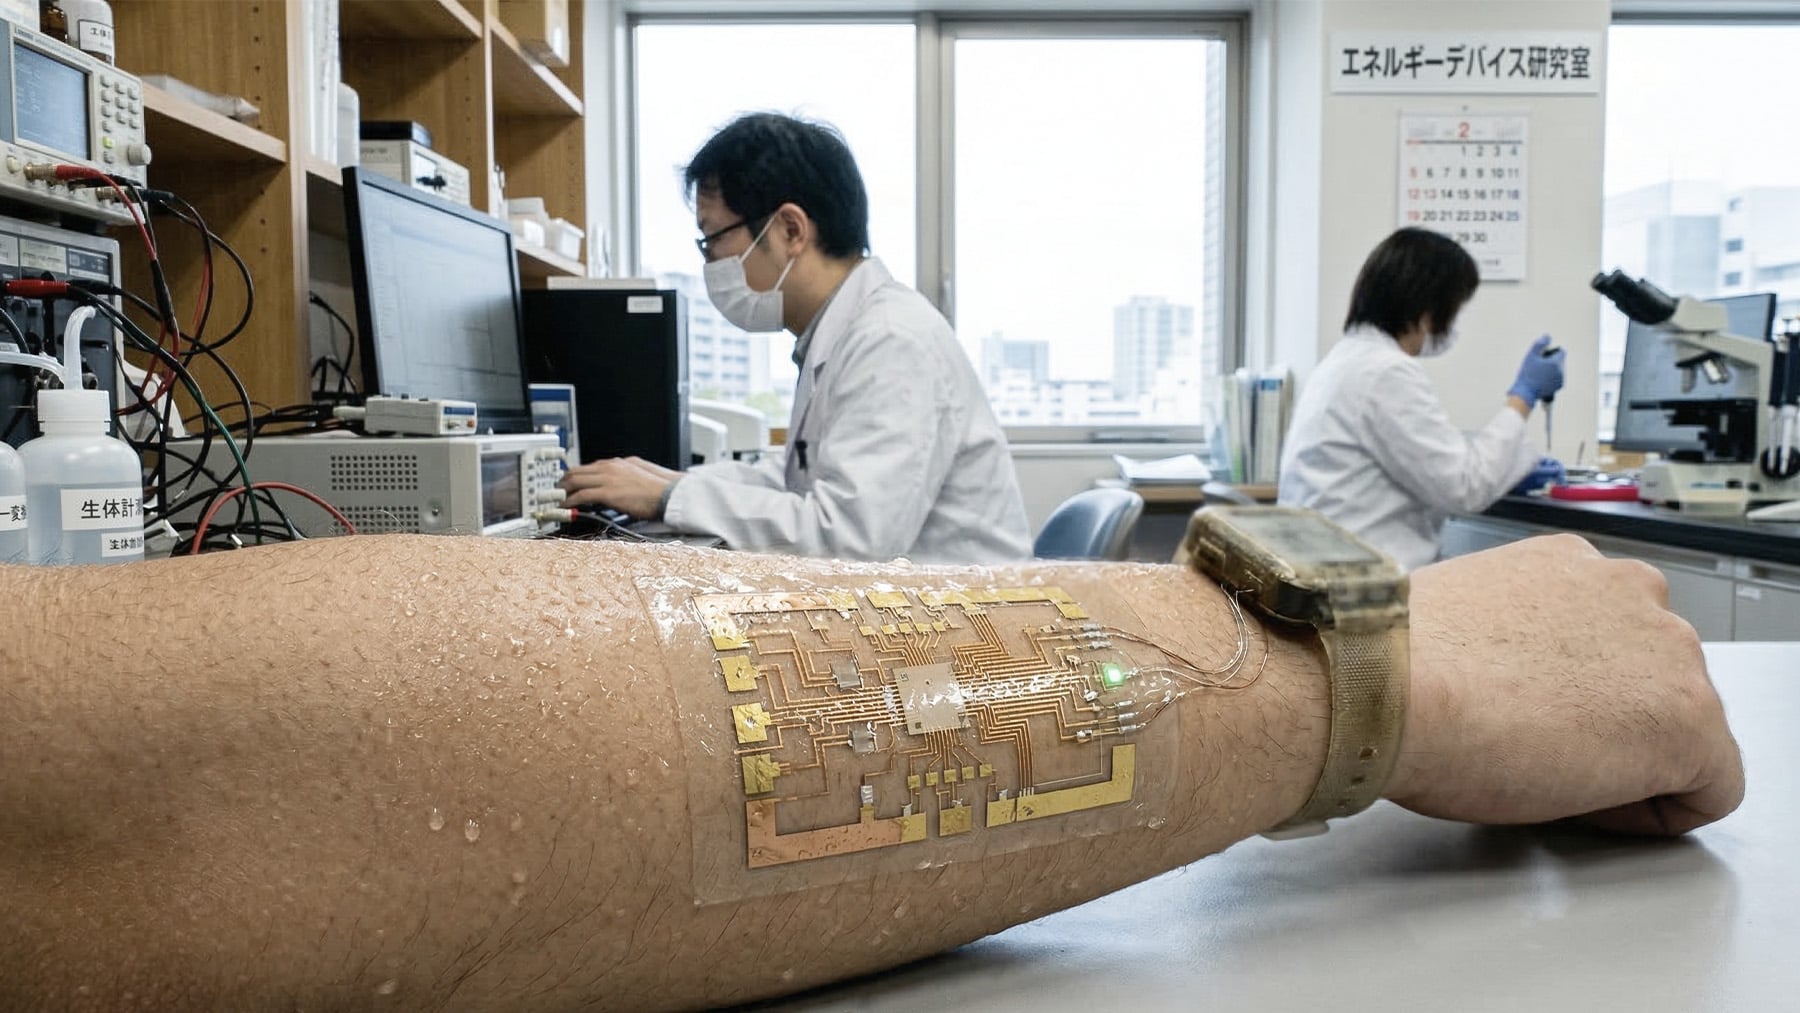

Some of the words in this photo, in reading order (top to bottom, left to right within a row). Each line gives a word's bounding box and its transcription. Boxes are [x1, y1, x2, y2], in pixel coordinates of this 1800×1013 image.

[1342, 45, 1590, 79] エネルギーデバイス研究室
[1458, 122, 1470, 138] 2
[1461, 145, 1467, 157] 1
[1477, 145, 1484, 157] 2
[1493, 145, 1501, 157] 3
[1510, 145, 1518, 157] 4
[1426, 167, 1434, 179] 6
[1443, 167, 1450, 179] 7
[1459, 167, 1467, 179] 8
[1476, 167, 1484, 179] 9
[1491, 167, 1504, 179] 10
[1507, 167, 1519, 179] 11
[1408, 189, 1420, 200] 12
[1423, 189, 1437, 200] 13
[1440, 189, 1453, 200] 14
[1457, 189, 1470, 200] 15
[1473, 189, 1487, 200] 16
[1489, 189, 1504, 200] 17
[1506, 189, 1520, 200] 18
[1408, 210, 1420, 222] 19
[1423, 210, 1437, 222] 20
[1440, 210, 1453, 222] 21
[1457, 210, 1470, 222] 22
[1473, 210, 1487, 222] 23
[1489, 210, 1504, 222] 24
[1506, 210, 1520, 222] 25
[1473, 232, 1487, 243] 30
